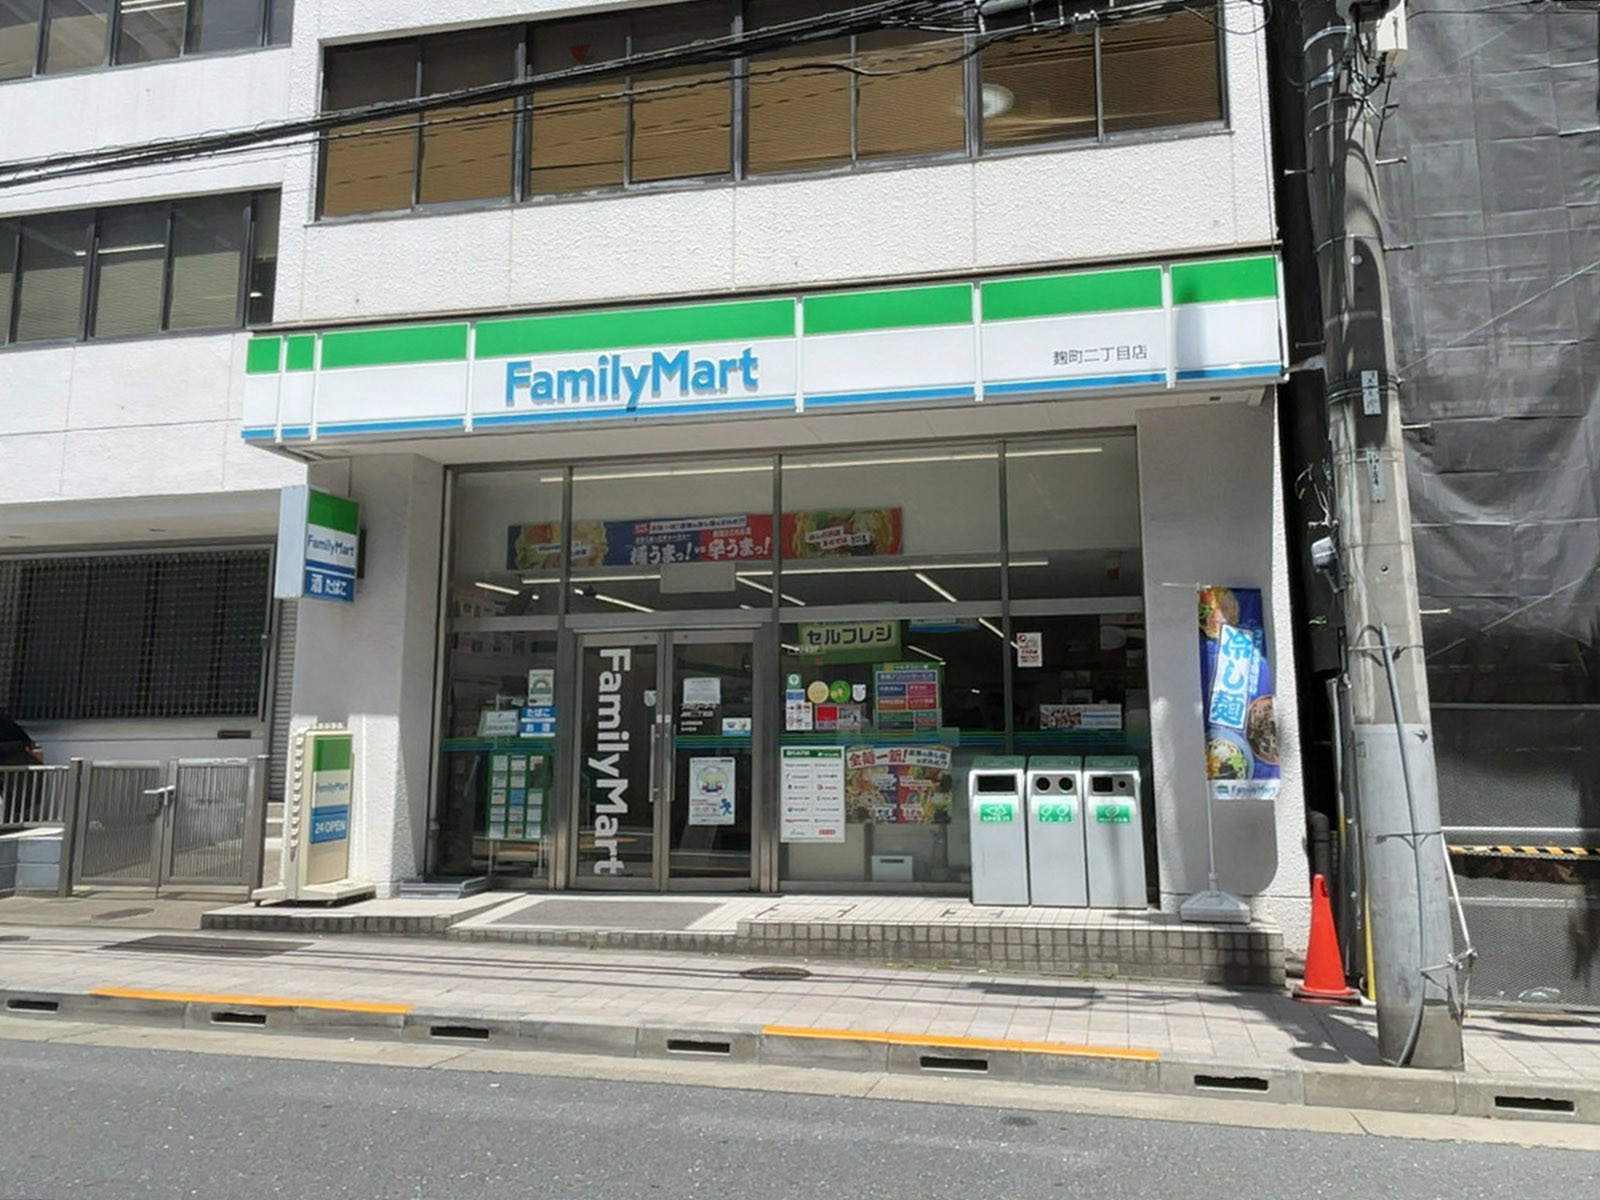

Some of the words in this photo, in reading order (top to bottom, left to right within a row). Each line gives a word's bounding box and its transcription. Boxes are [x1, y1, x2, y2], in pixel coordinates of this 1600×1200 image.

[1053, 344, 1147, 366] 麹町二丁目店
[506, 348, 758, 409] FamilyMart
[307, 534, 355, 557] FamilyMart
[807, 625, 892, 646] セルフレジ
[1210, 626, 1253, 726] 冷し麺
[527, 708, 551, 718] たばこ
[588, 648, 631, 875] FamilyMart
[316, 781, 349, 795] FamilyMart
[325, 820, 346, 833] OPEN
